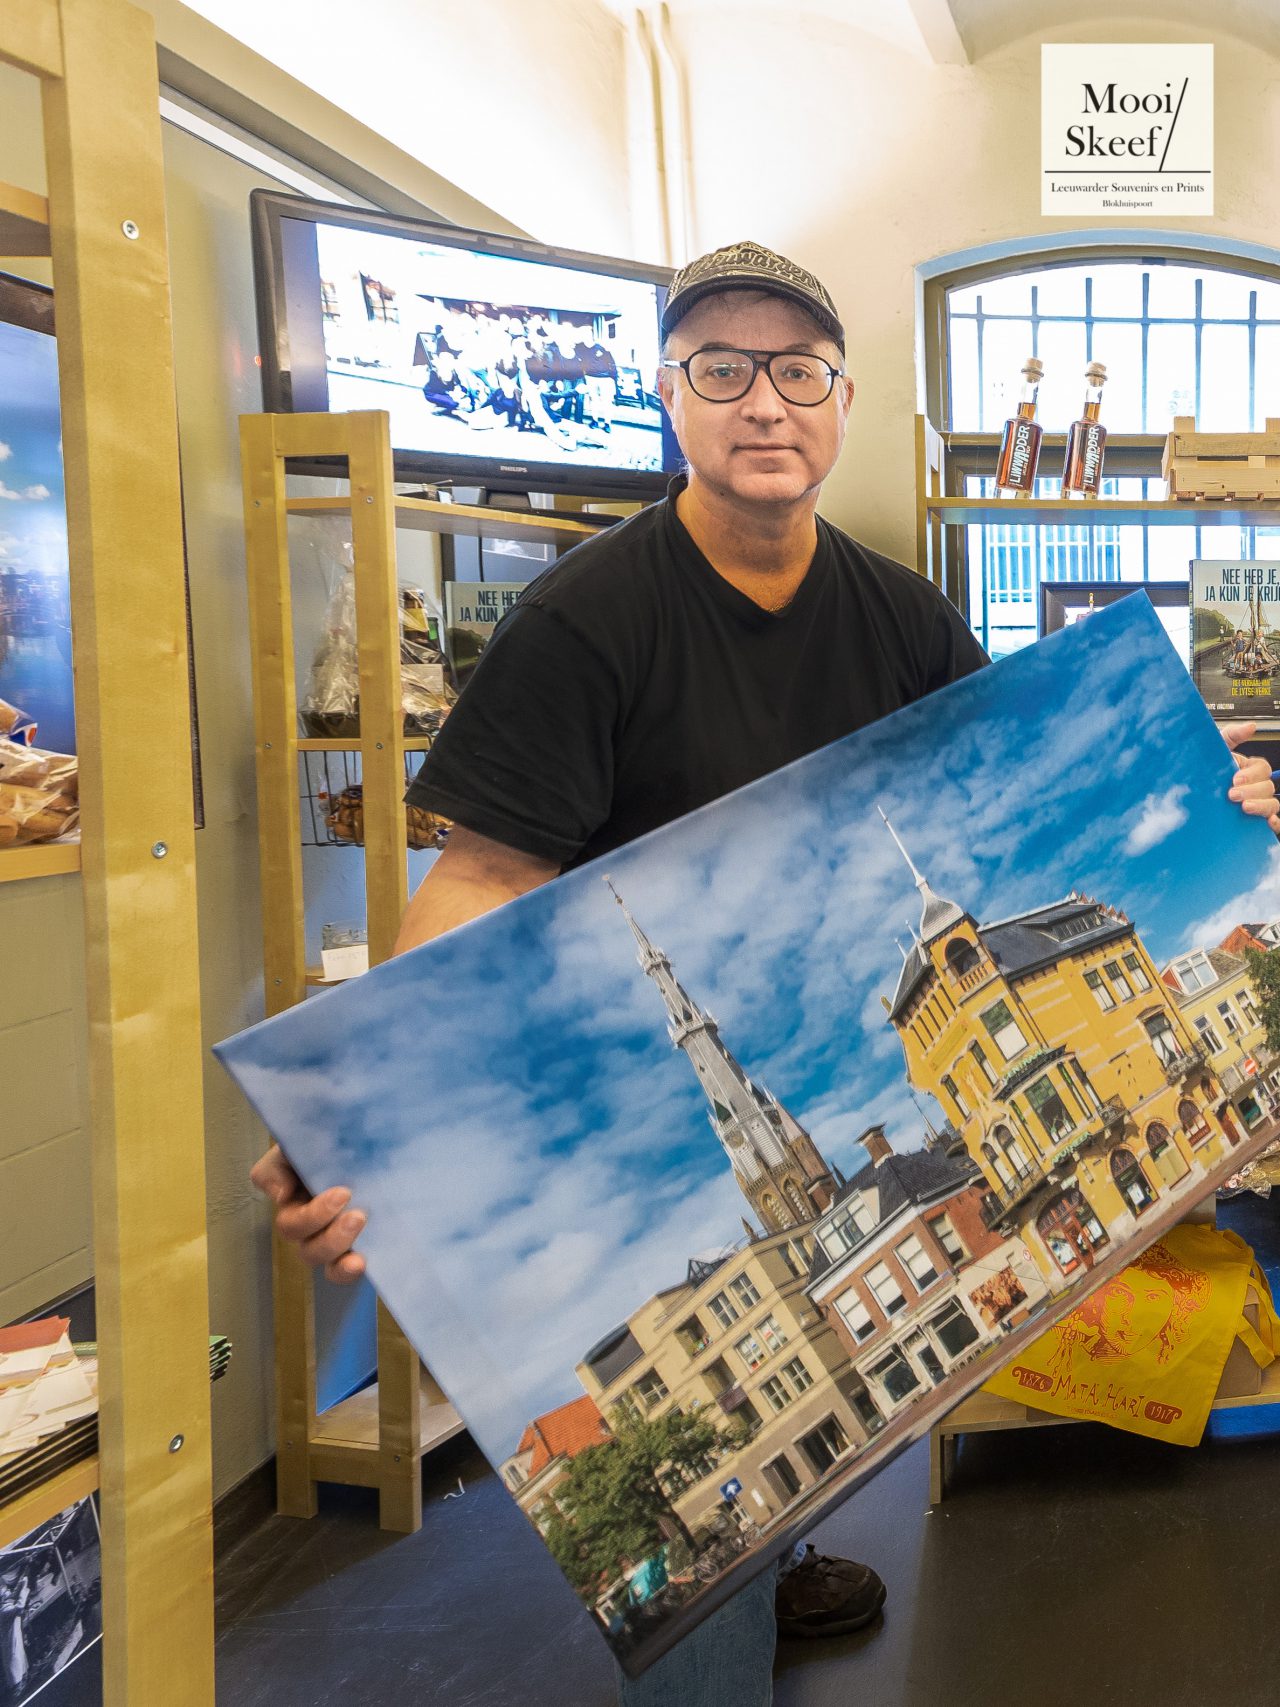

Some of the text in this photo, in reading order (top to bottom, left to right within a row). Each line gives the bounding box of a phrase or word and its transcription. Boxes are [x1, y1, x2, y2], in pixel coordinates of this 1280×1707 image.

[1081, 82, 1174, 114] Mooi
[1065, 124, 1163, 157] Skeef
[1051, 182, 1205, 193] Leeuwarder Souvenirs en Prints
[1102, 199, 1153, 209] Blokhuispoort
[1222, 568, 1280, 586] NEE HEB JE,
[477, 590, 498, 606] NEE
[1204, 585, 1216, 602] JA
[1219, 585, 1240, 602] KUN
[1243, 585, 1254, 602] JE
[458, 607, 498, 622] JA KUN
[1231, 687, 1239, 696] DE
[1022, 1371, 1046, 1390] 1876
[1051, 1374, 1100, 1406] MATA
[1102, 1383, 1145, 1418] HARI
[1150, 1405, 1174, 1420] 1917
